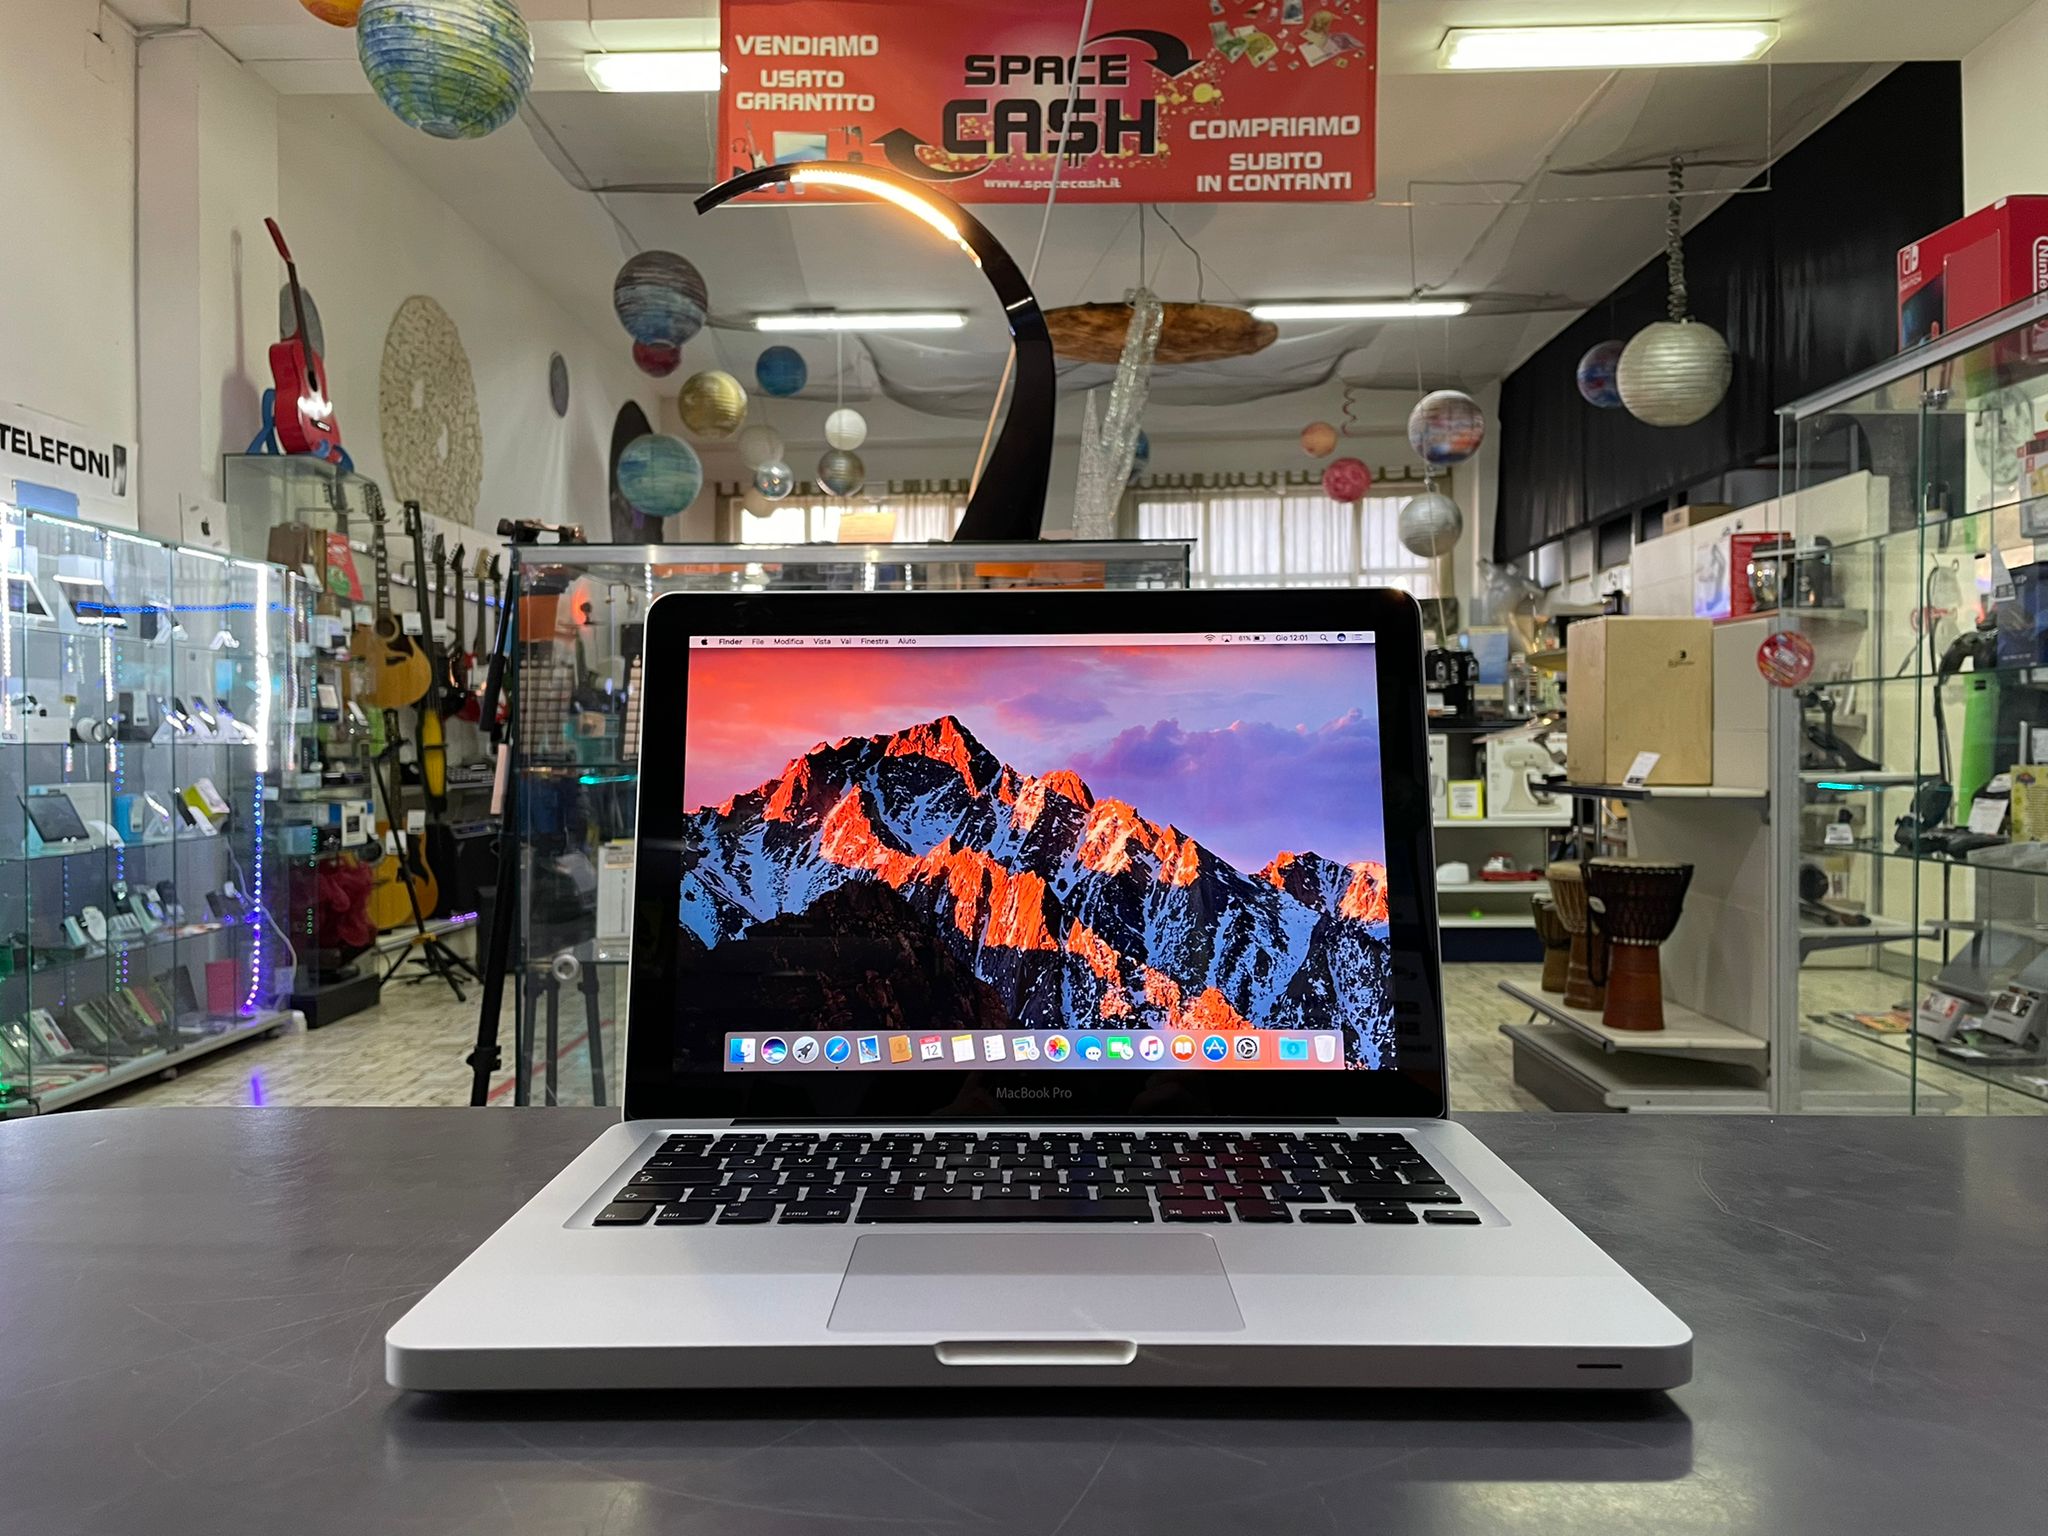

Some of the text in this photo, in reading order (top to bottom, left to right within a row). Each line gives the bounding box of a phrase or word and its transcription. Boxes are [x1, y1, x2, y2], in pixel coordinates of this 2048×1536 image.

[735, 34, 879, 57] VENDIAMO
[760, 69, 844, 88] USATO
[964, 54, 1129, 86] SPACE
[736, 92, 875, 112] GARANTITO
[1189, 115, 1360, 140] COMPRIAMO
[1229, 151, 1322, 171] SUBITO
[1196, 171, 1352, 193] IN CONTANTI
[0, 422, 110, 479] TELEFONI
[925, 1044, 939, 1057] 12
[996, 1086, 1073, 1099] MacBook Pro
